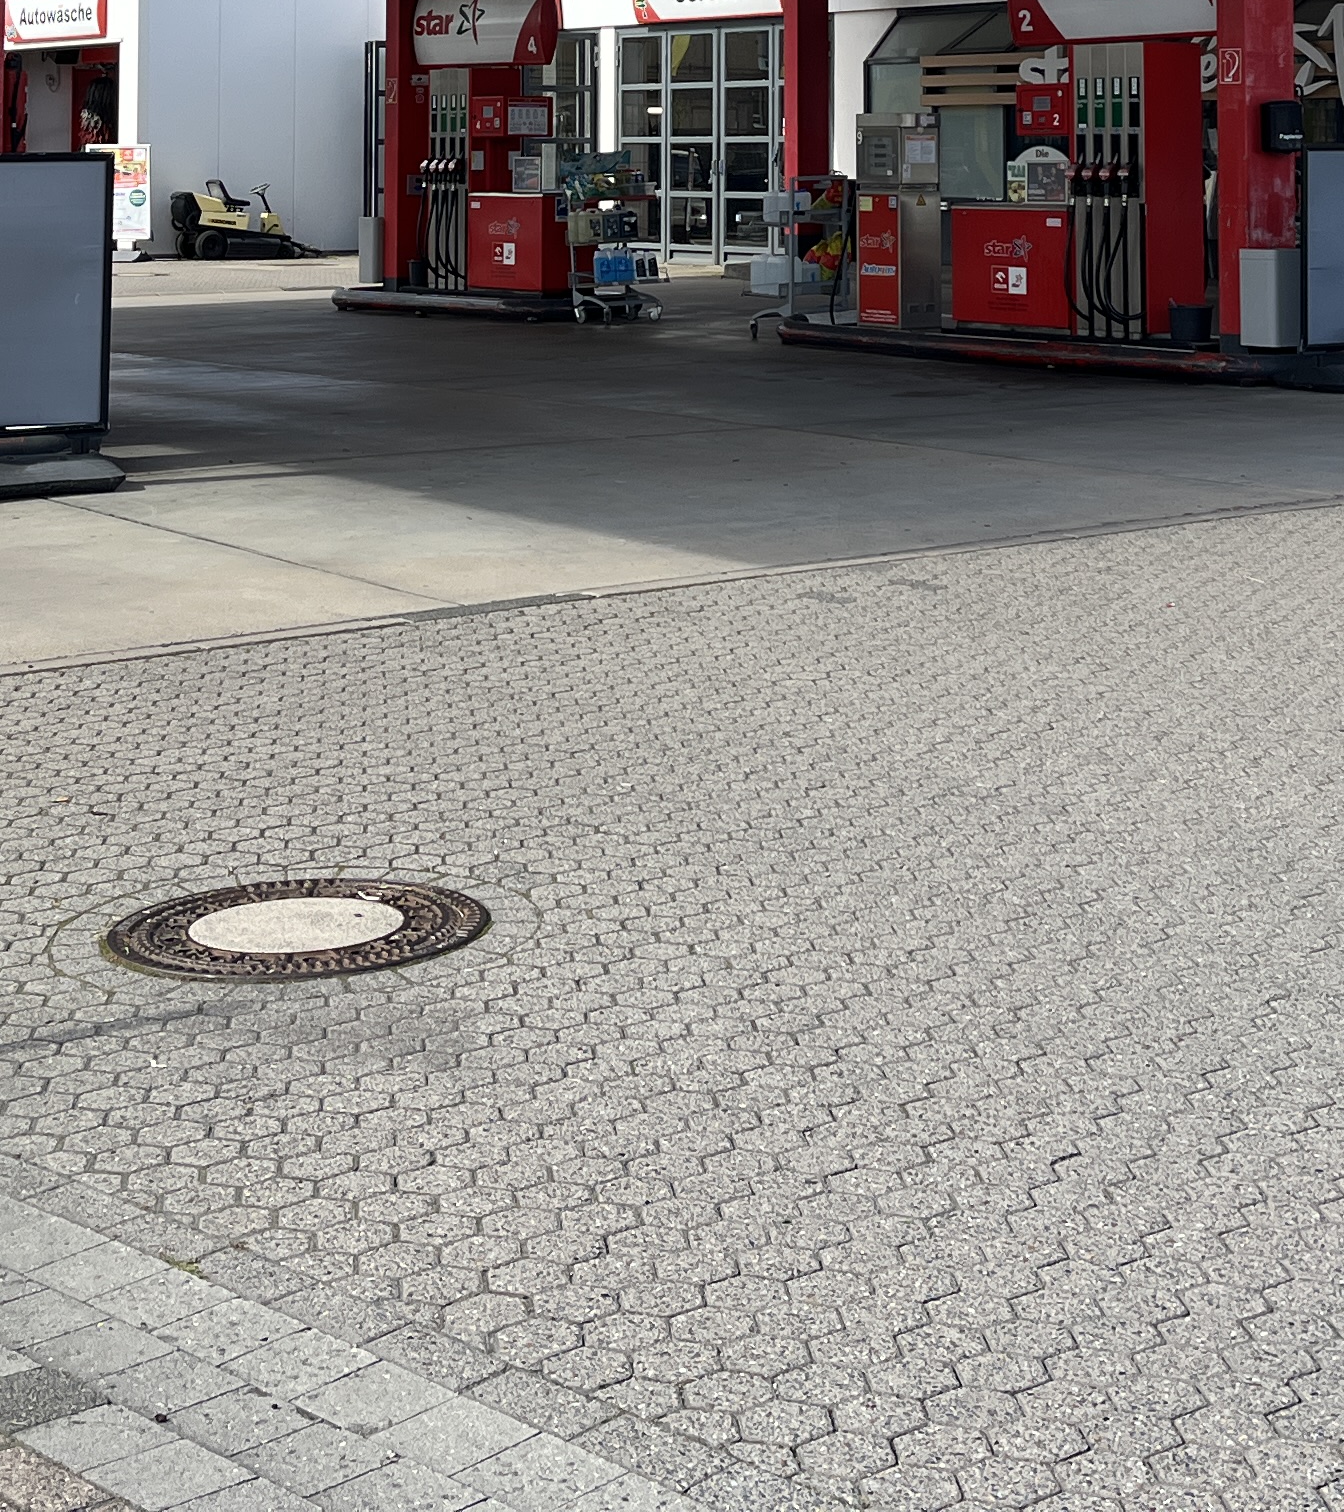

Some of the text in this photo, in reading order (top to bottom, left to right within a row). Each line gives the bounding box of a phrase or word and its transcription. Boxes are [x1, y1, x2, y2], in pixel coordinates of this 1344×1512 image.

[19, 3, 93, 26] Autowäsche
[414, 8, 454, 36] star
[1018, 9, 1034, 32] 2
[527, 36, 537, 55] 4
[1052, 113, 1060, 126] 2
[856, 130, 863, 145] 9
[859, 234, 882, 249] star
[983, 240, 1012, 257] star
